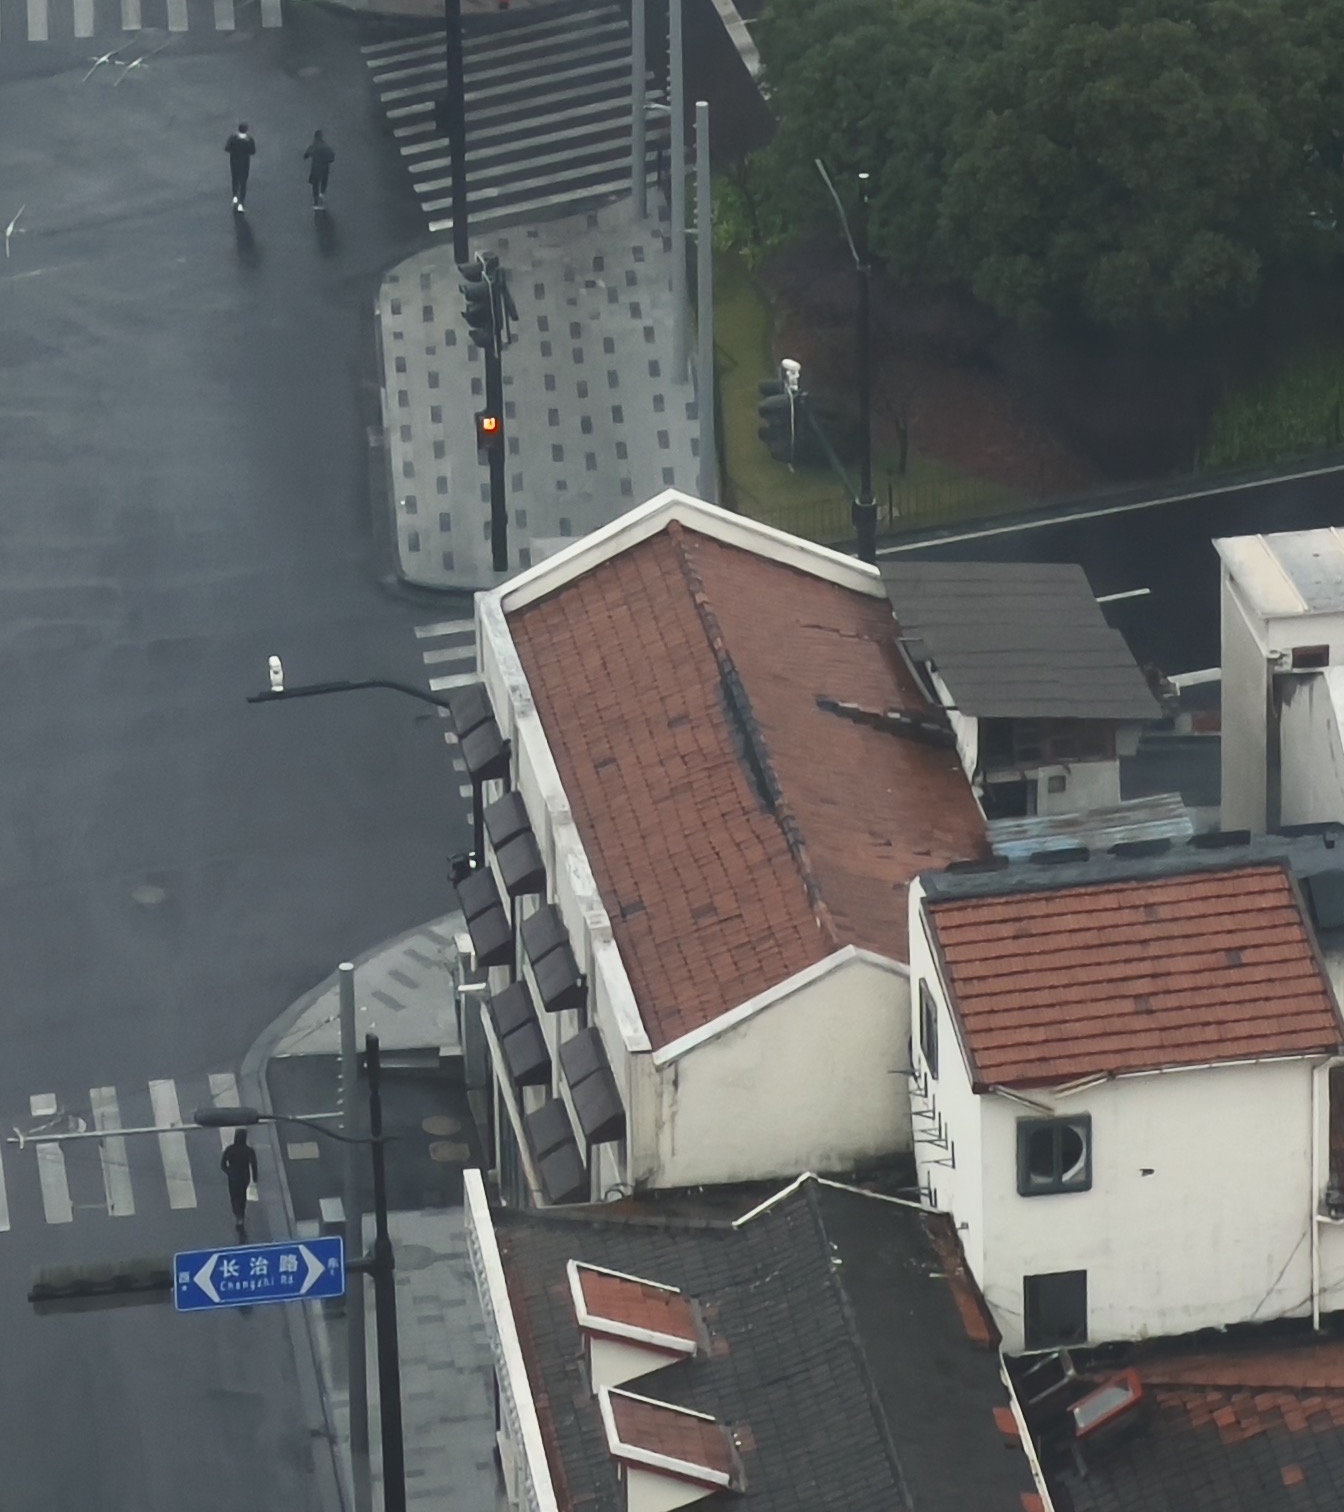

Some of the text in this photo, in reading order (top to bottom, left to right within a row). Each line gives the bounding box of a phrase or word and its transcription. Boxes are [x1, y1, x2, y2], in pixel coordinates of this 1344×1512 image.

[219, 1254, 298, 1278] 长治路
[220, 1275, 274, 1291] Changzhi
